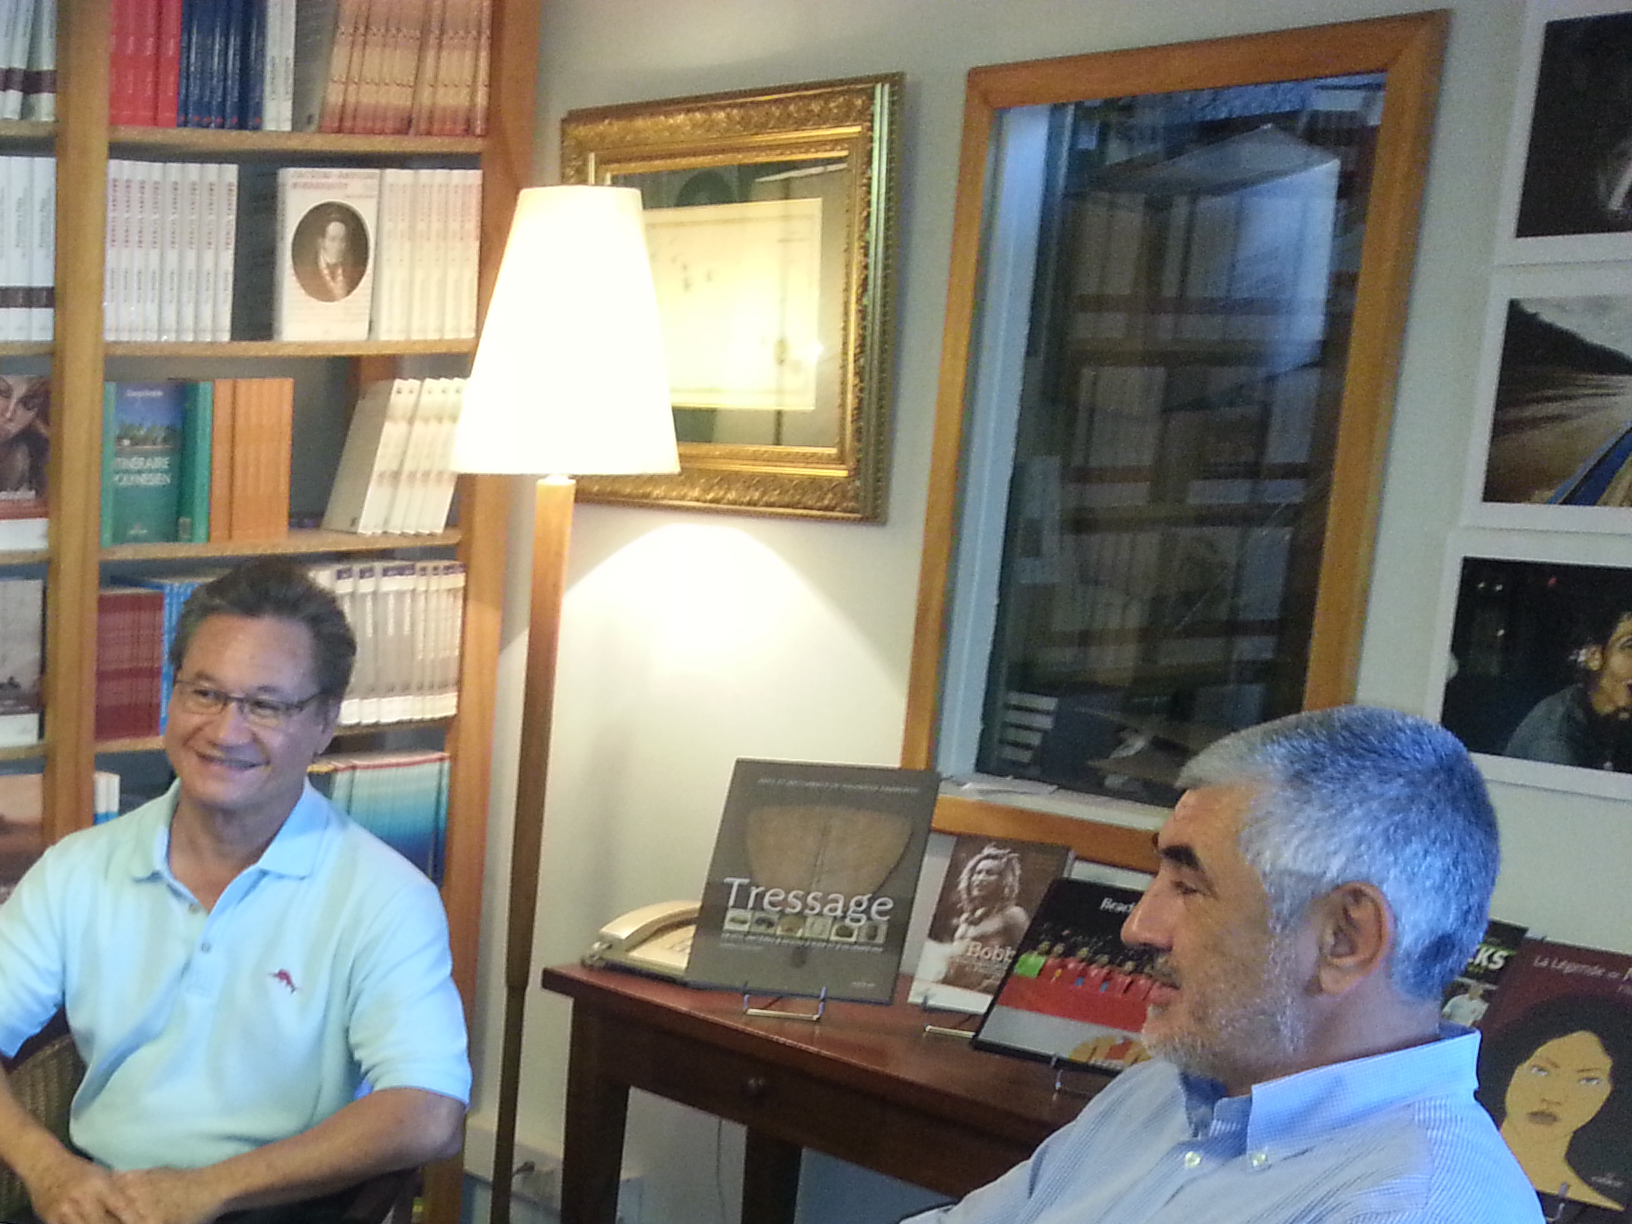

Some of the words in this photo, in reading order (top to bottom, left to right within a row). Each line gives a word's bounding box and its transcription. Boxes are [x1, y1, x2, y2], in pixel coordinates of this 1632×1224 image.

[723, 877, 894, 926] Tressage
[967, 941, 1017, 963] Bobb
[1469, 945, 1508, 970] KS
